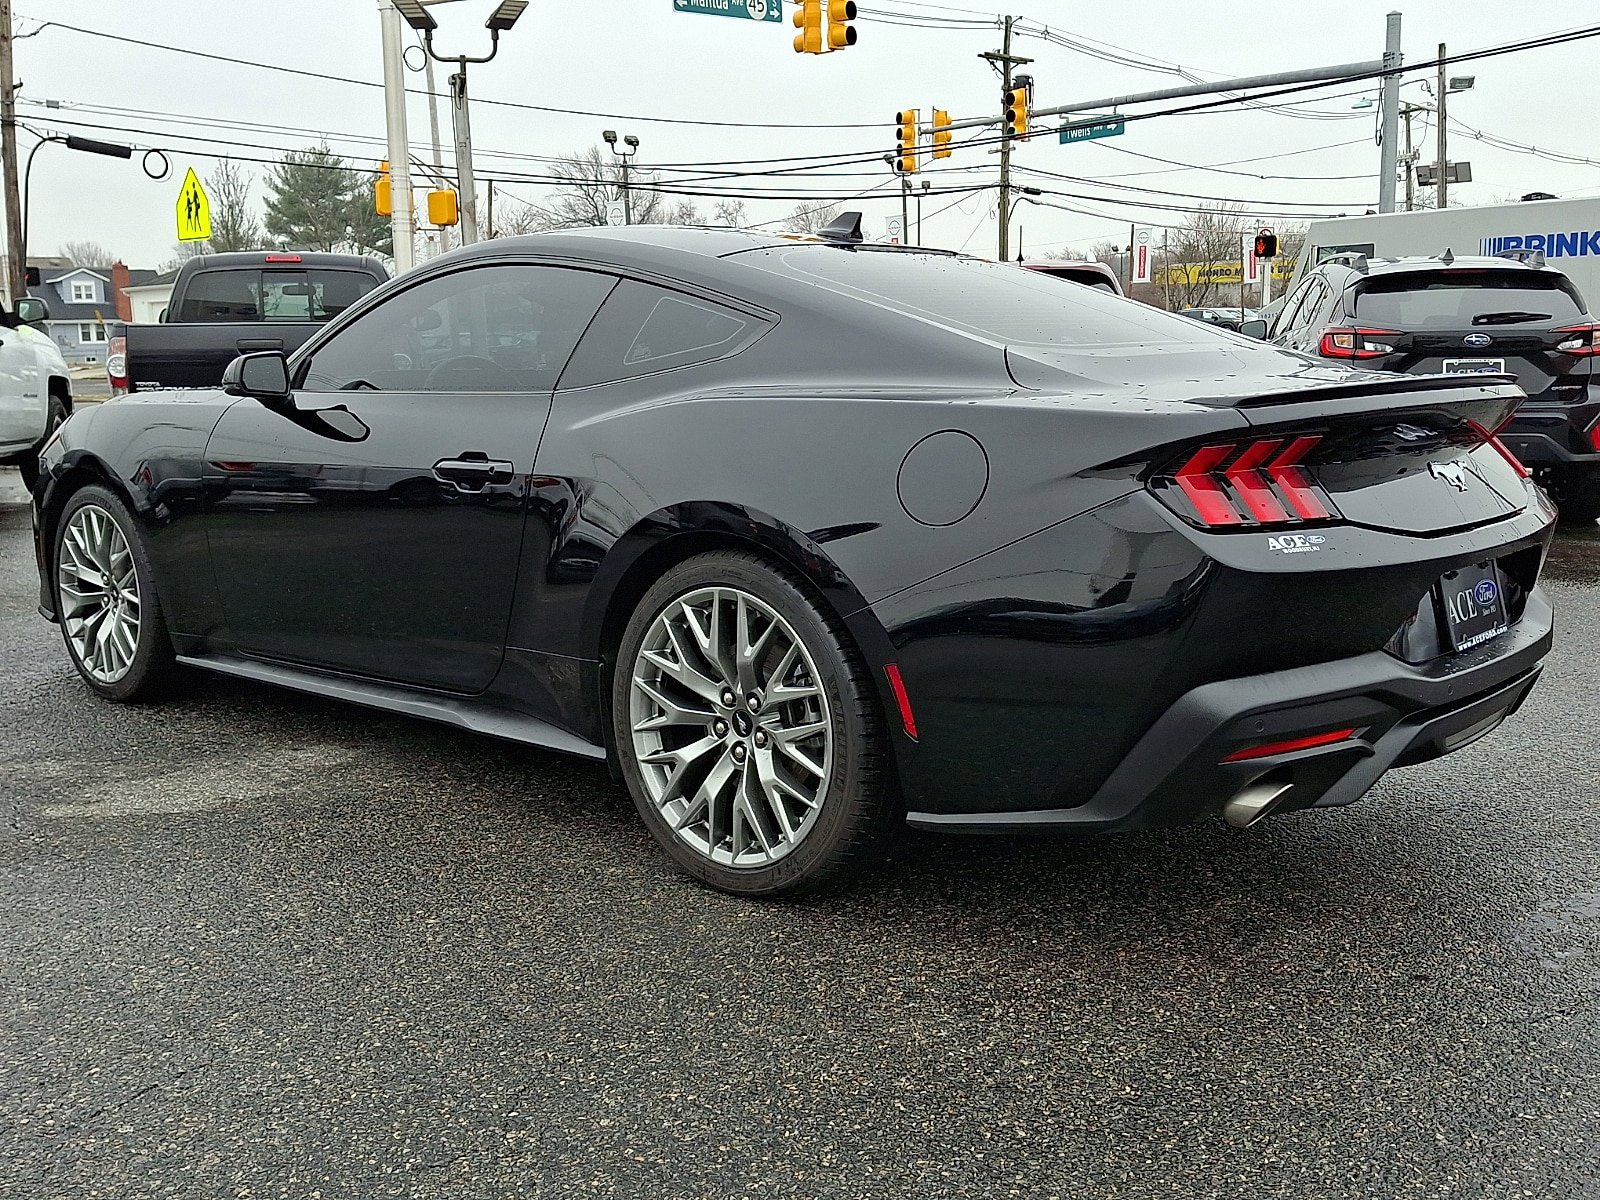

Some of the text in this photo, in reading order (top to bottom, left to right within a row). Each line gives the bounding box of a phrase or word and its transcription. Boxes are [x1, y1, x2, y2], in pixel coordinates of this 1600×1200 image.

[748, 0, 765, 12] 45
[1267, 535, 1310, 550] ACE
[1478, 583, 1494, 602] Ford
[1448, 588, 1478, 625] ACE
